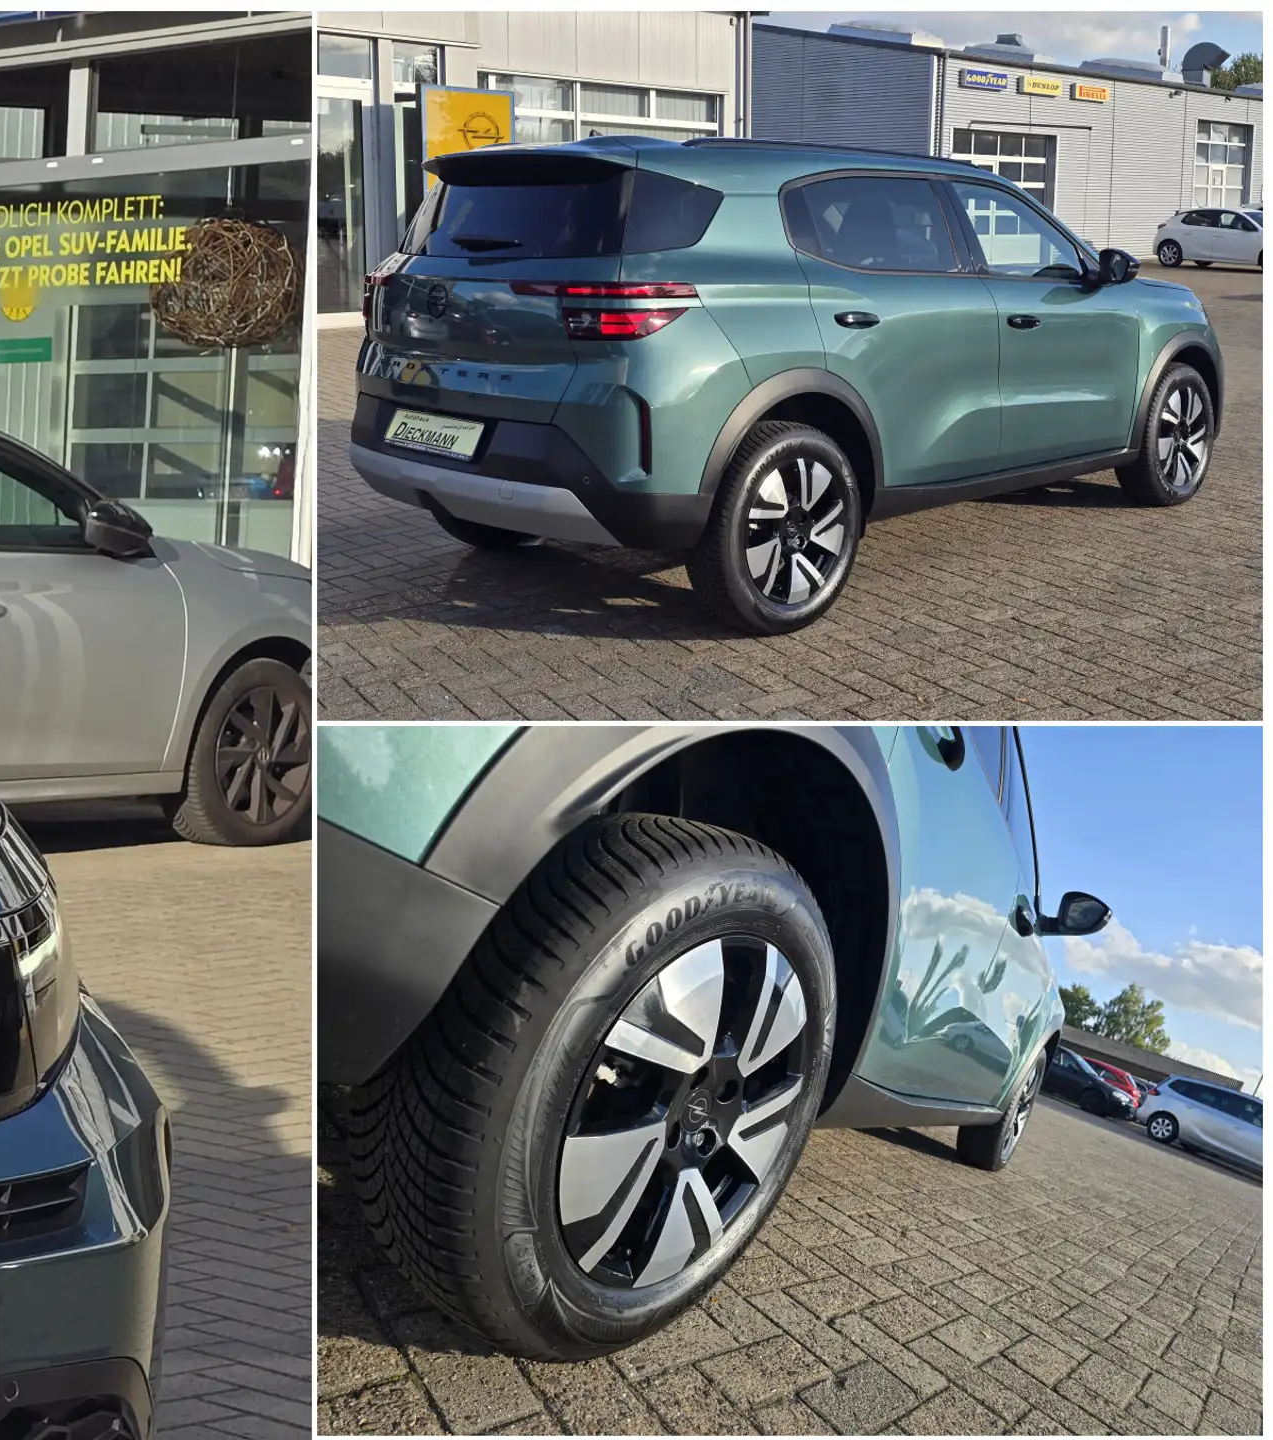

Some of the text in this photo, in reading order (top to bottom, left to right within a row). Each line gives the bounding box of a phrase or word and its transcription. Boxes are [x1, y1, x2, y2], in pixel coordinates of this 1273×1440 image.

[1032, 81, 1060, 91] DUNLOP
[1078, 85, 1107, 100] PIRELLI
[57, 195, 164, 225] KOMPLETT:
[5, 233, 54, 258] OPEL
[28, 262, 90, 287] PROBE
[96, 257, 182, 285] FAHREN!
